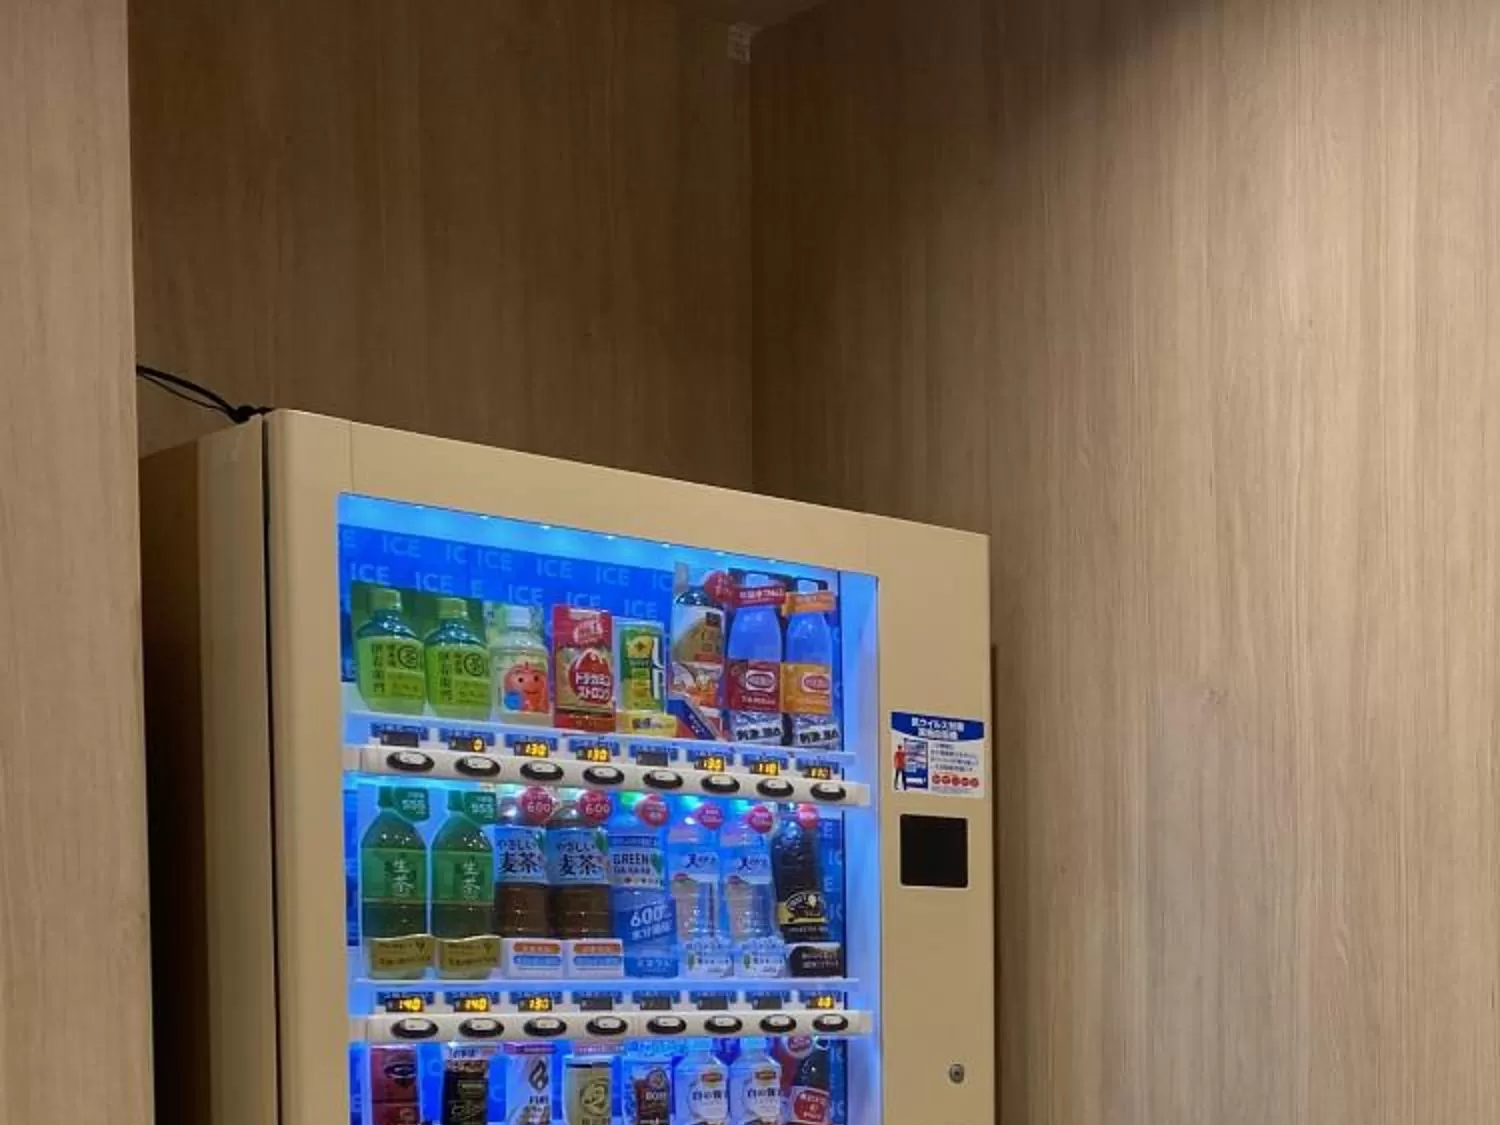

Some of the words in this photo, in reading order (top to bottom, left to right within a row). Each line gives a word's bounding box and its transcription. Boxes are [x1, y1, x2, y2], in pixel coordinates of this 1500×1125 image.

[382, 534, 421, 558] ICE
[446, 543, 468, 565] IC
[477, 549, 513, 572] ICE
[536, 557, 573, 579] ICE
[351, 561, 391, 586] ICE
[415, 571, 453, 595] ICE
[595, 565, 631, 587] ICE
[652, 573, 672, 592] IC
[507, 583, 544, 606] ICE
[624, 599, 657, 619] ICE
[585, 803, 610, 815] 600
[502, 851, 538, 874] 麦茶
[560, 852, 598, 876] 麦茶
[613, 853, 649, 866] GREEN
